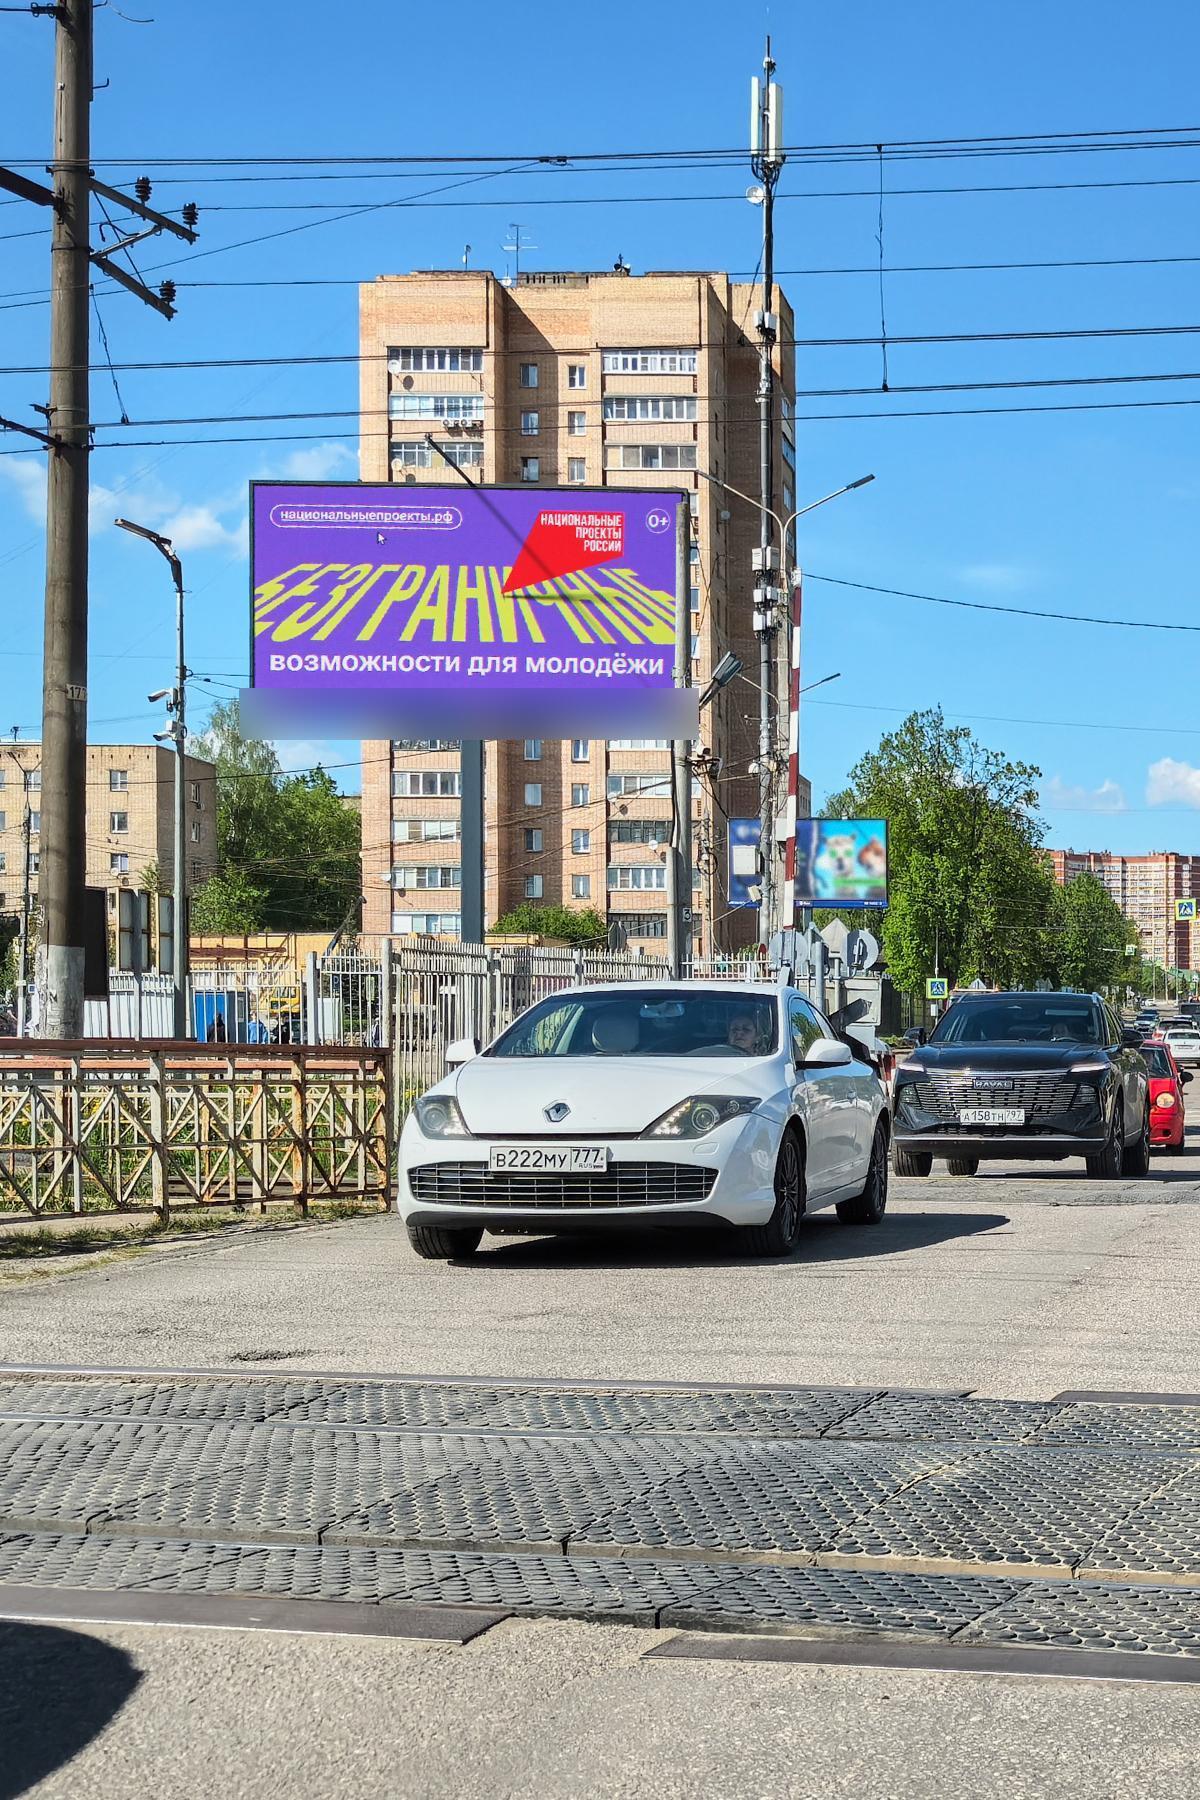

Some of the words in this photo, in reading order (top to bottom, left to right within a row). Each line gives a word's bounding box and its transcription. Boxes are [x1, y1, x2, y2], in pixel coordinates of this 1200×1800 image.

[280, 510, 453, 524] национальныепроекты.рф
[540, 513, 622, 527] НАЦИОНАЛЬНЫЕ
[648, 514, 669, 528] 0+
[575, 526, 622, 539] ПРОЕКТЫ
[583, 539, 622, 552] РОССИИ
[269, 653, 460, 673] возможности
[467, 656, 517, 676] для
[525, 653, 664, 678] молодёжи
[964, 1110, 1004, 1121] А158ТН
[496, 1149, 568, 1169] В222МУ
[572, 1148, 601, 1163] 777
